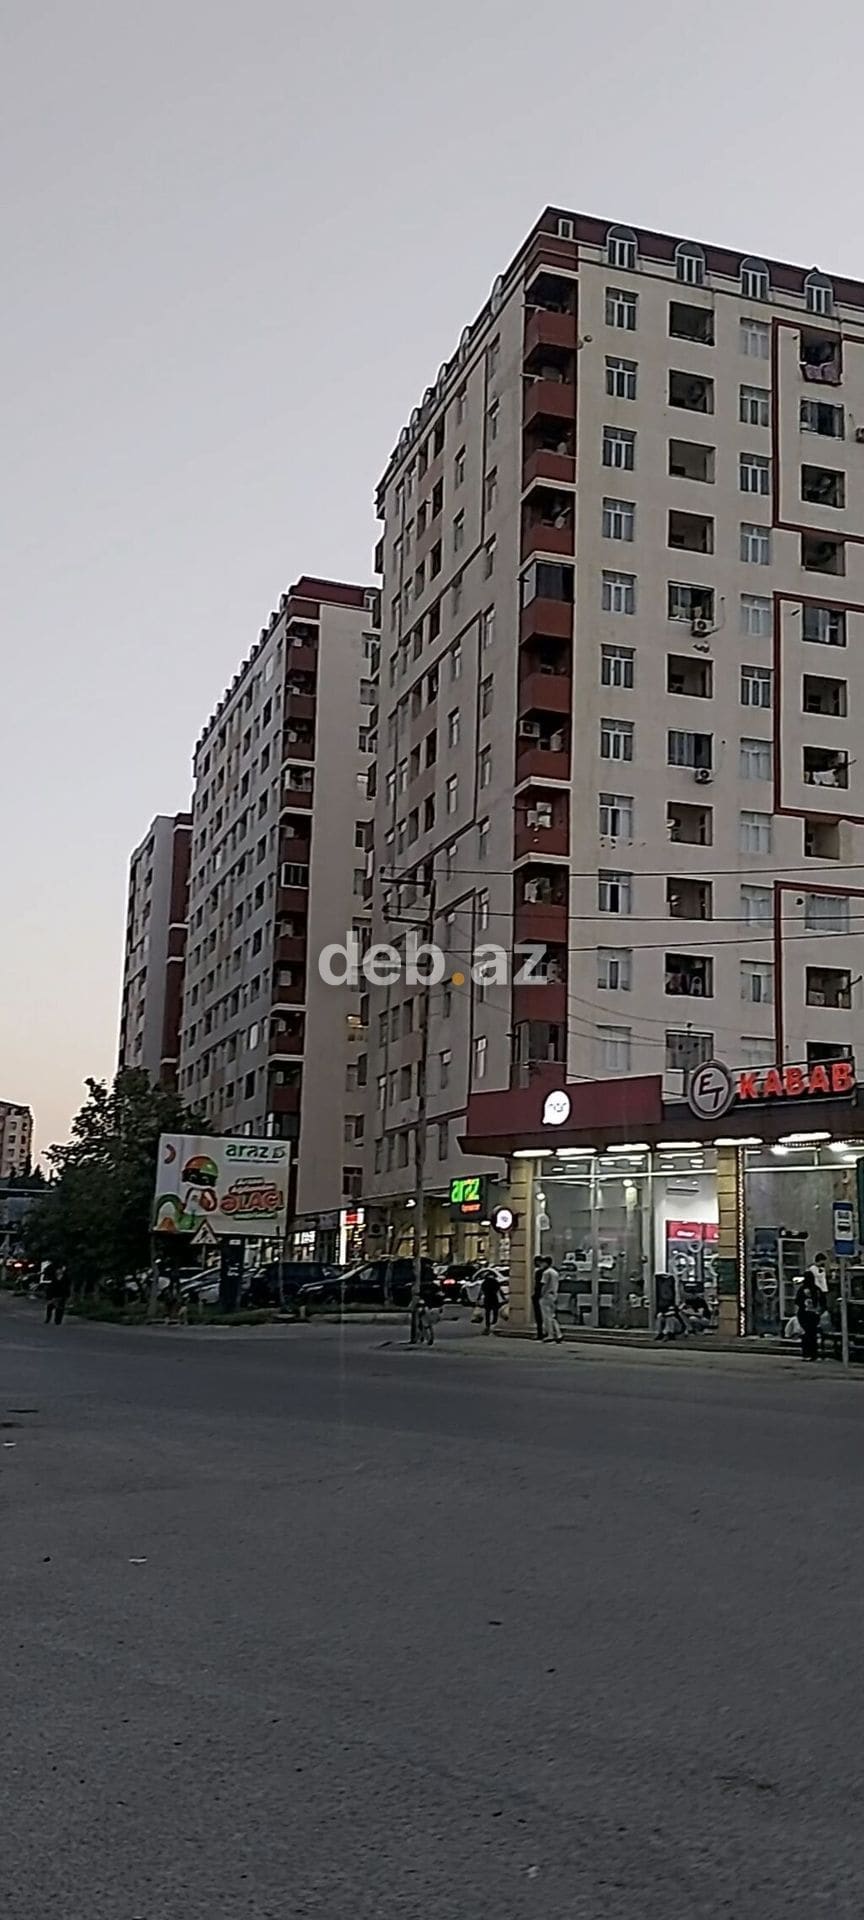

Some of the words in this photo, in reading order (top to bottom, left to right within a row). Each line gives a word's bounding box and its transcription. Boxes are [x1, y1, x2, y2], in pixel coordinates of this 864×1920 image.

[698, 1073, 724, 1108] ET
[738, 1062, 855, 1100] KABAB
[225, 1144, 269, 1158] araz
